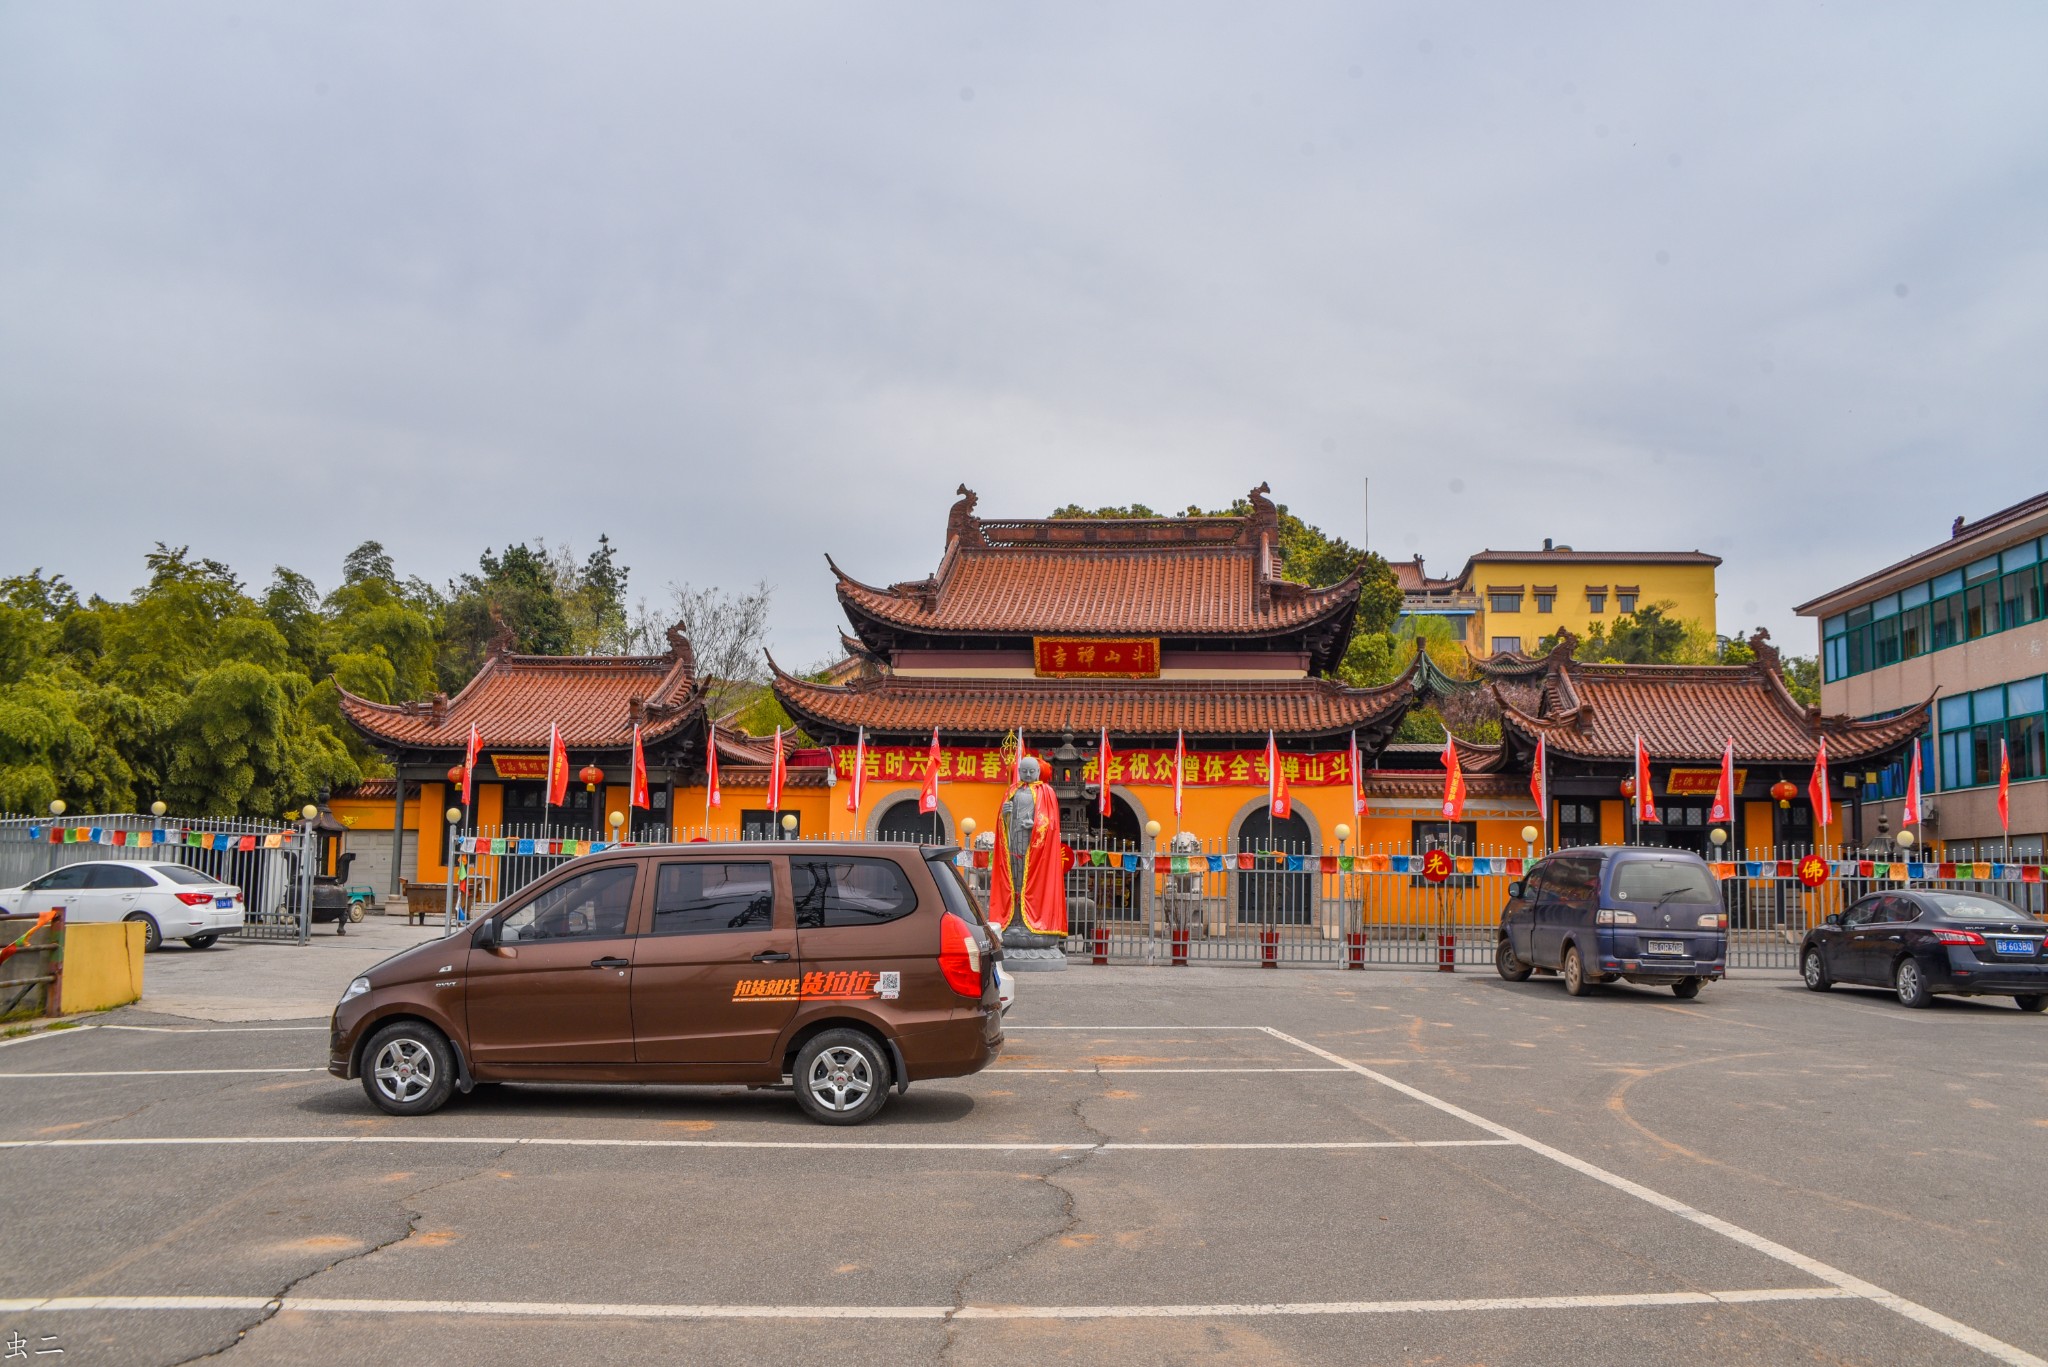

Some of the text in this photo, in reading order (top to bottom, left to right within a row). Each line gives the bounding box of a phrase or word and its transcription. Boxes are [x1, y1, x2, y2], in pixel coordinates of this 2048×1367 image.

[1426, 854, 1448, 875] 光
[1802, 859, 1824, 882] 佛
[733, 971, 872, 997] 拉货就找 货拉拉
